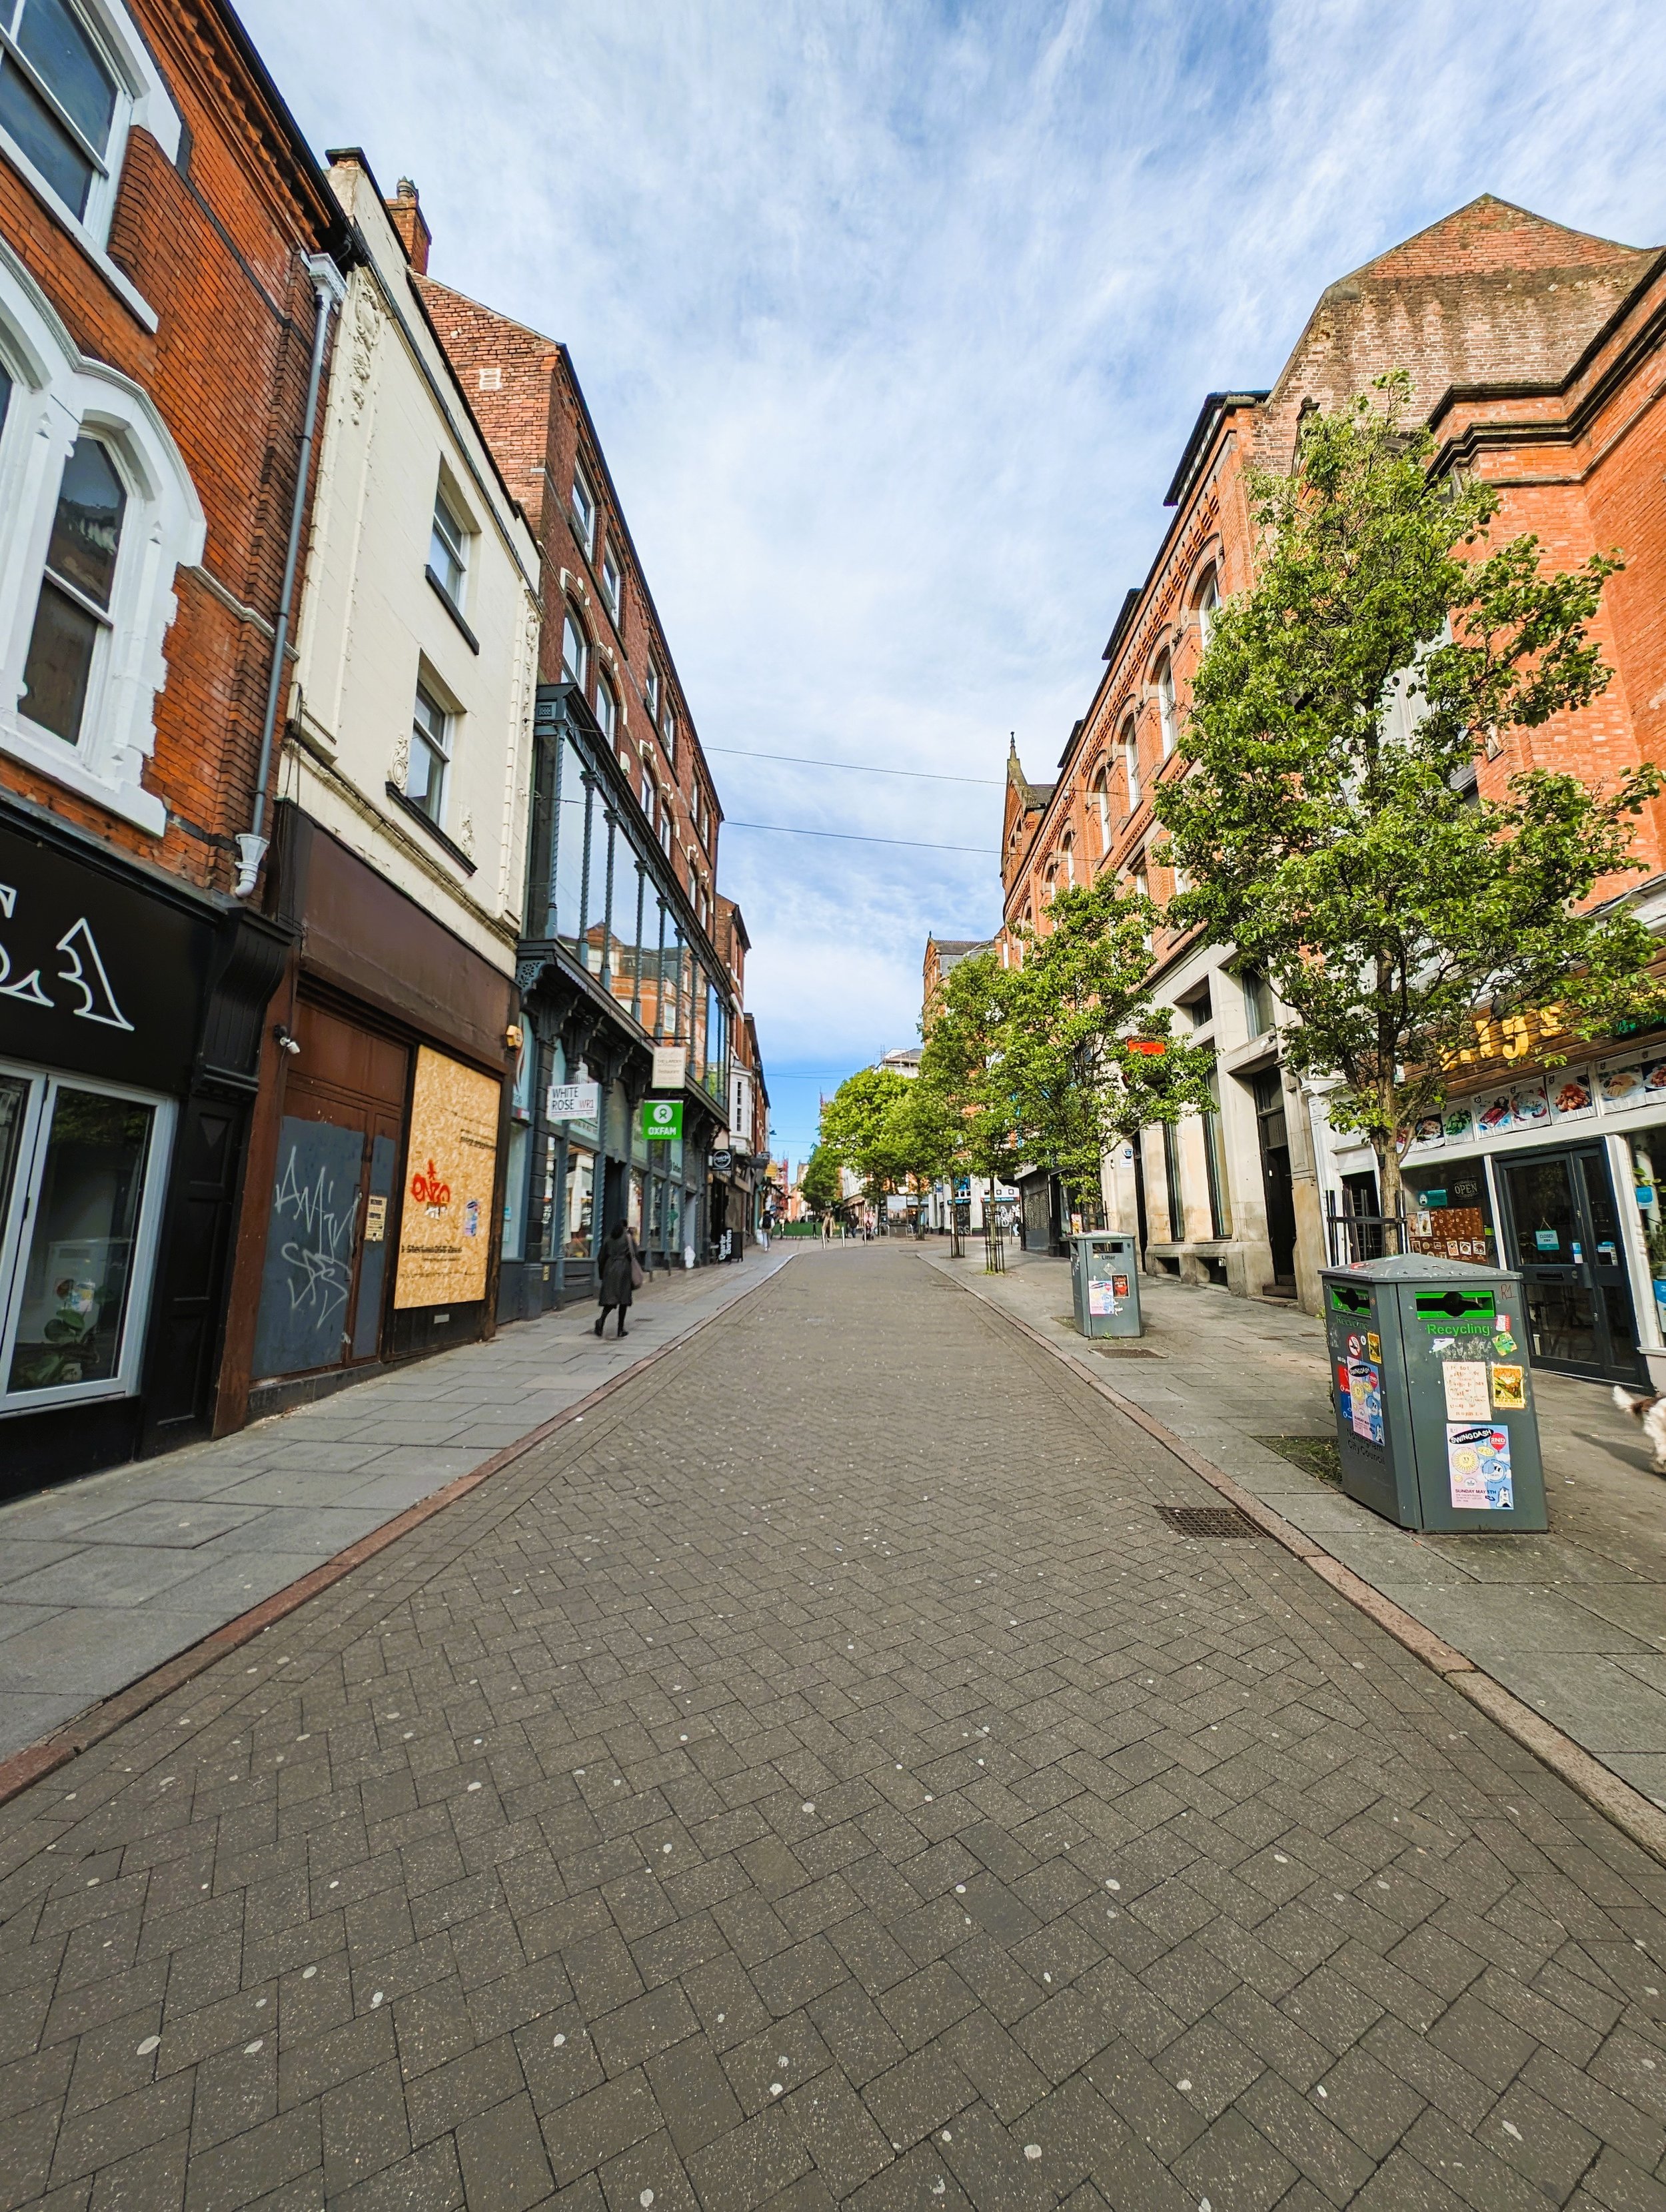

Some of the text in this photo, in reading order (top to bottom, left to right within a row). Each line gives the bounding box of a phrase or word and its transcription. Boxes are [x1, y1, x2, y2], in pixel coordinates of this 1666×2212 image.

[552, 1087, 579, 1099] WHITE
[552, 1099, 594, 1111] ROSE WR1
[648, 1127, 676, 1135] OXFAM
[1454, 1183, 1478, 1195] OPEN
[1427, 1323, 1491, 1337] Recycling
[1347, 1439, 1385, 1465] City Council
